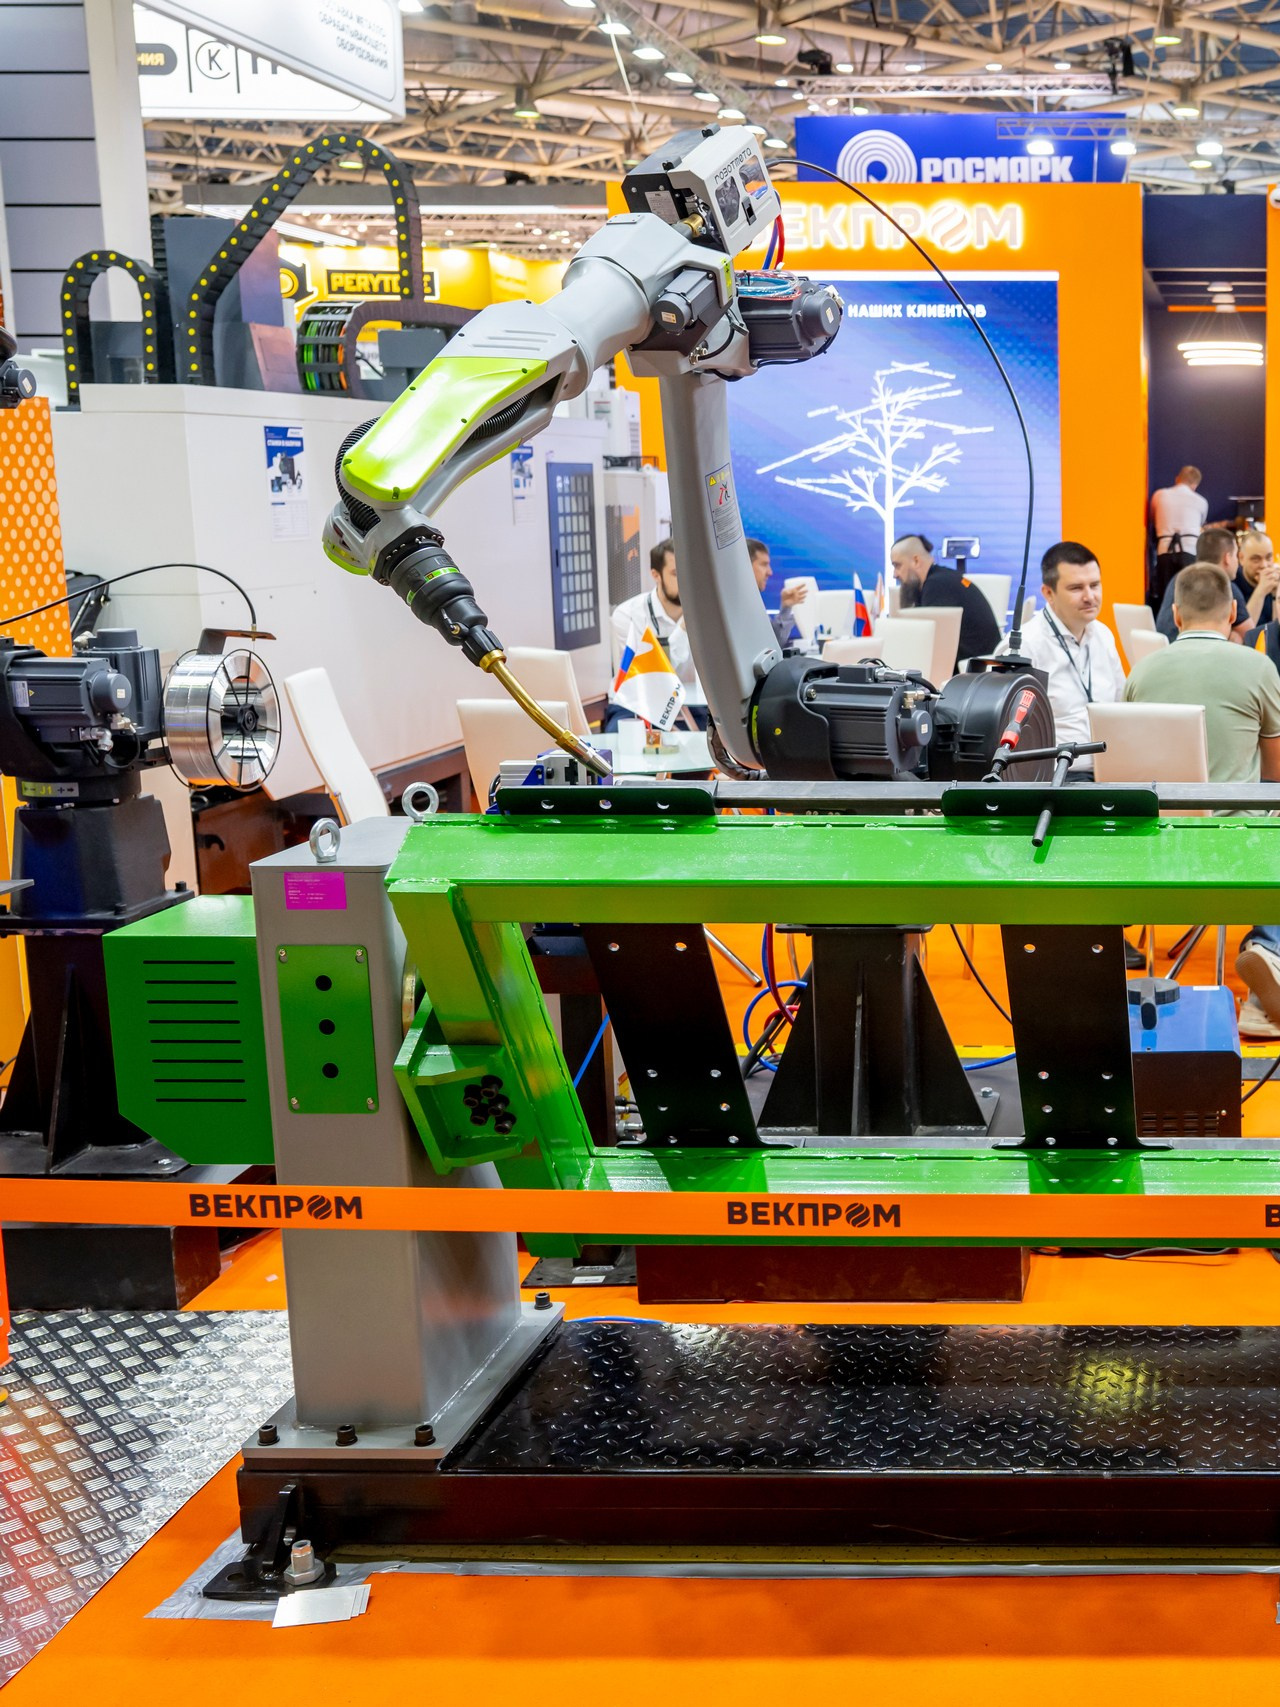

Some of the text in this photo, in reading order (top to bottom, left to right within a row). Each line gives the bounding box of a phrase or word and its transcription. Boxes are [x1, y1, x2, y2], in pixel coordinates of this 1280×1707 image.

[921, 156, 1074, 183] РОСМАРК
[847, 303, 987, 319] НАШИХ КЛИЕНТОВ
[189, 1193, 362, 1219] ВЕКПРОМ
[727, 1201, 900, 1227] ВЕКПРОМ
